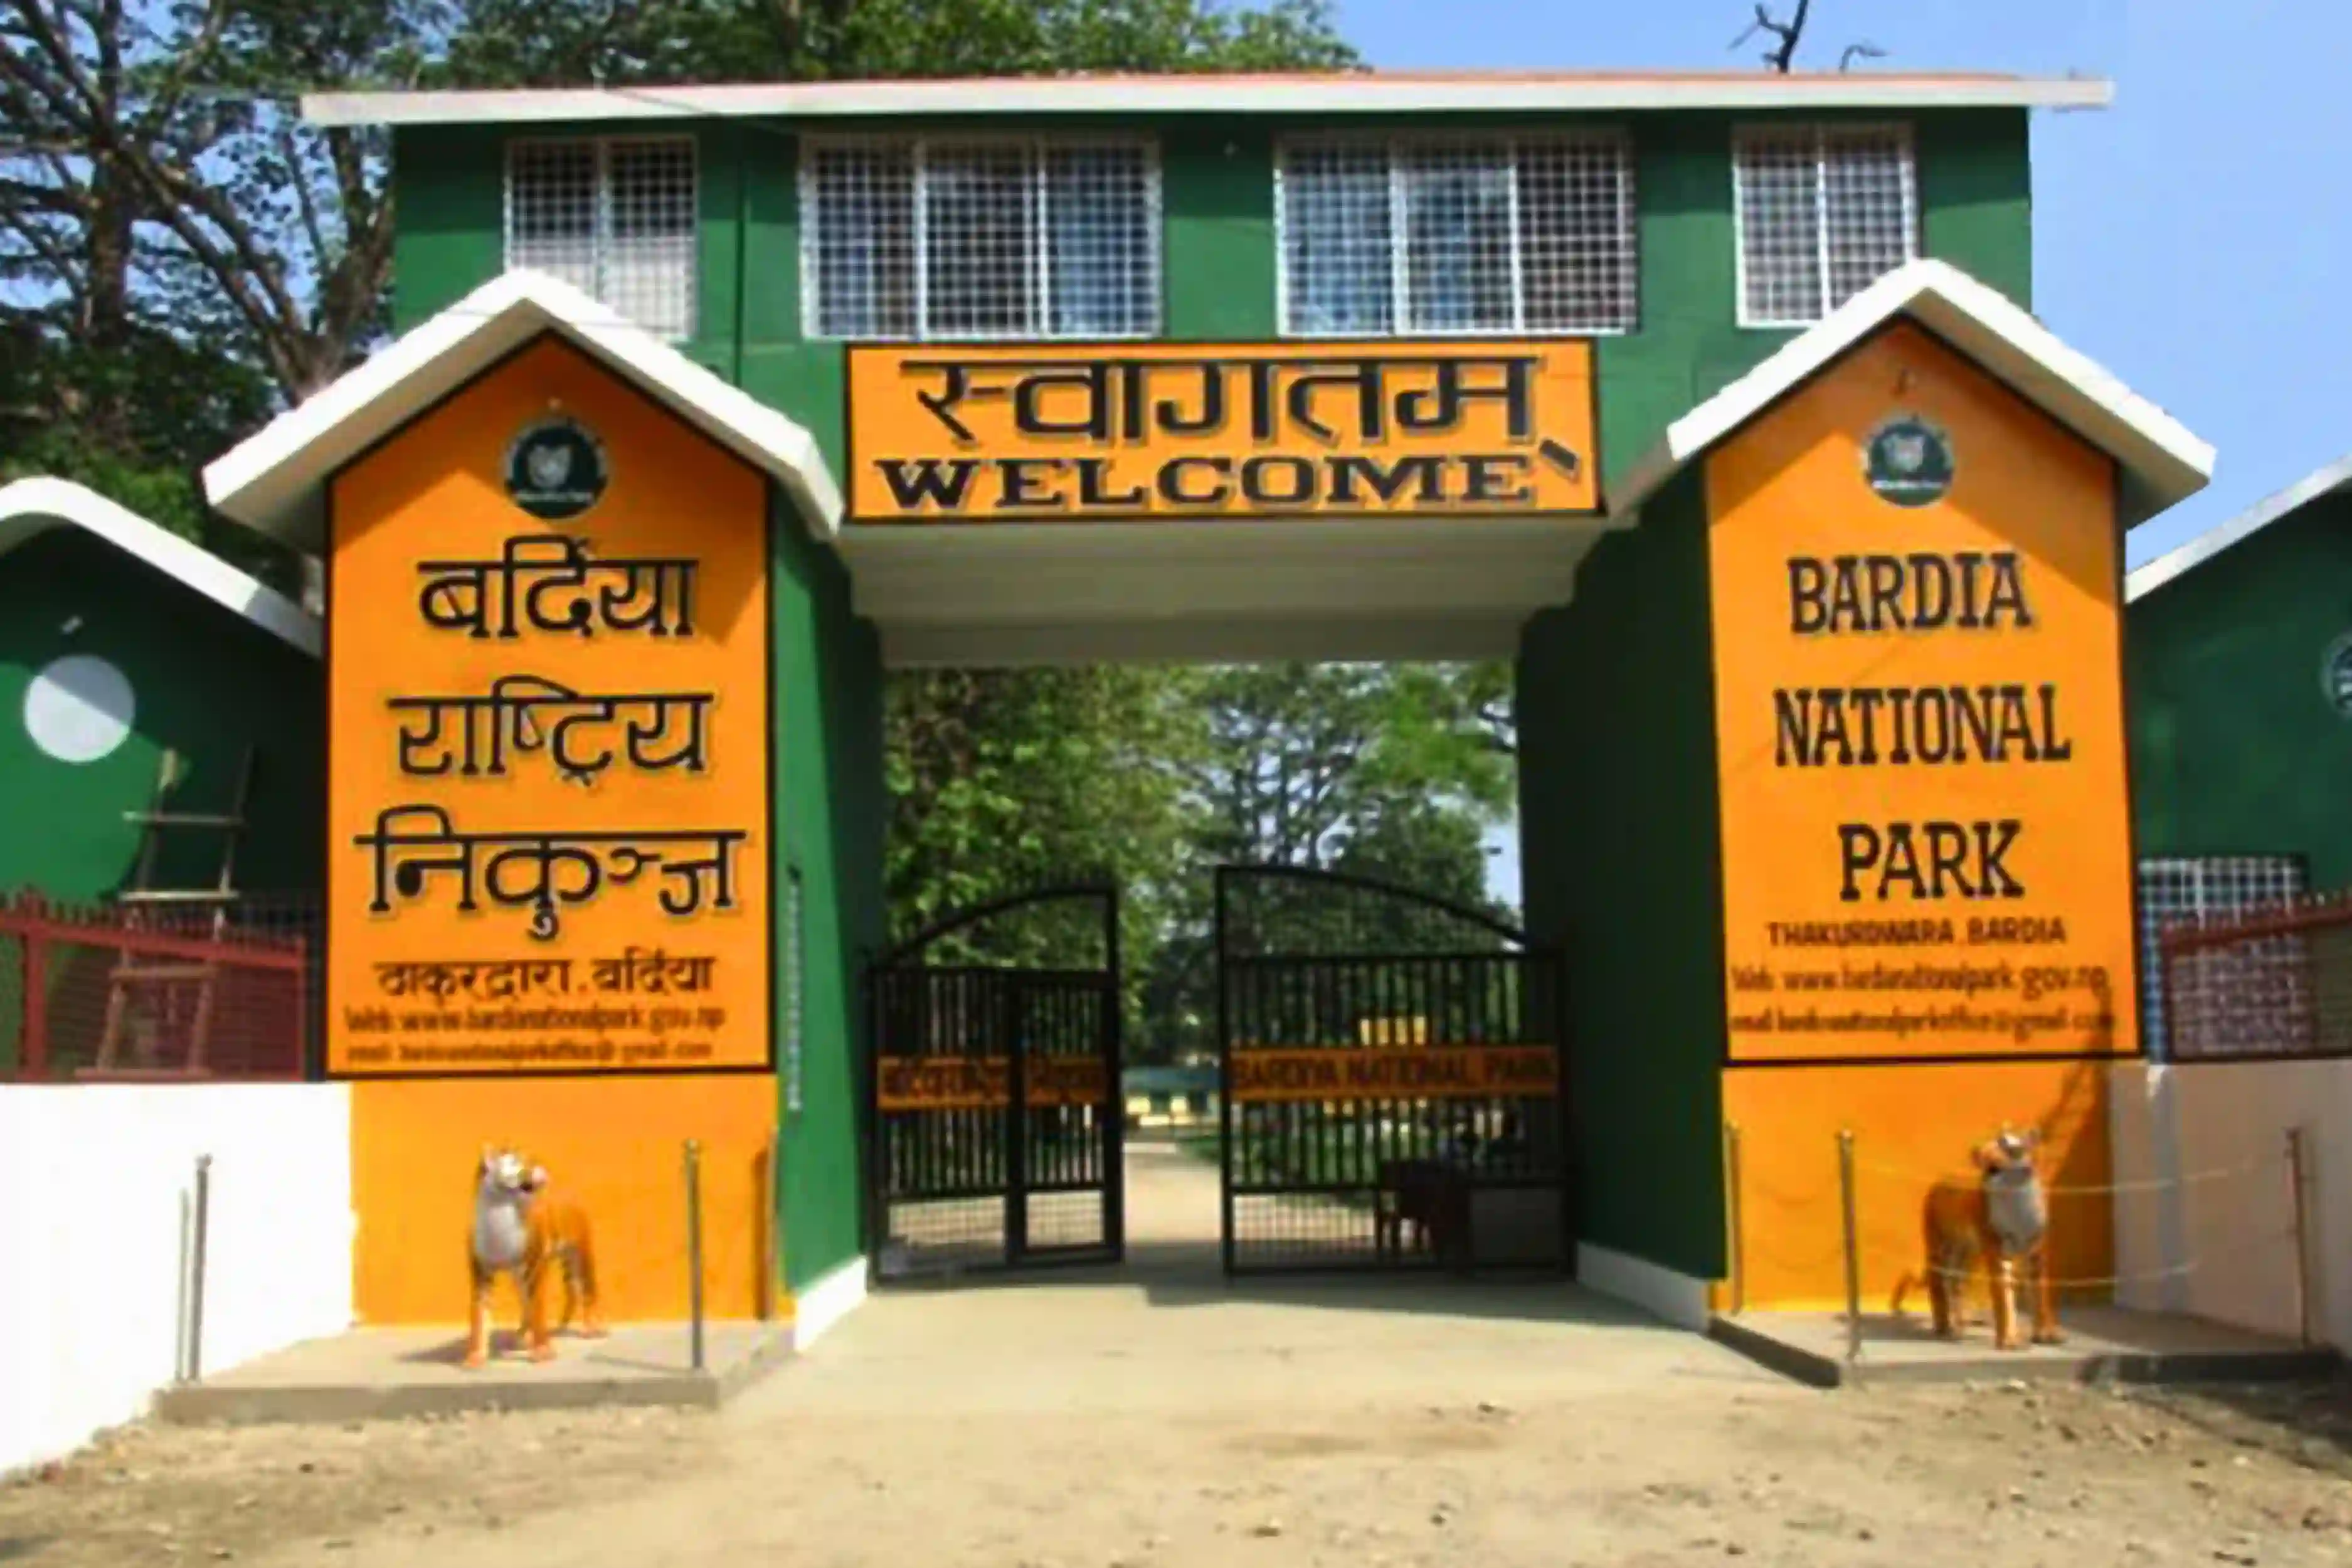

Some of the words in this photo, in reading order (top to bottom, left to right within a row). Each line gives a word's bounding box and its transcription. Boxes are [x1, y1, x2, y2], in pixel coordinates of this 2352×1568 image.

[874, 455, 1532, 509] WELCOME
[1786, 551, 2032, 633] BARDIA
[1772, 684, 2072, 766] NATIONAL
[1836, 819, 2026, 901] PARK
[1966, 916, 2067, 946] BARDIA
